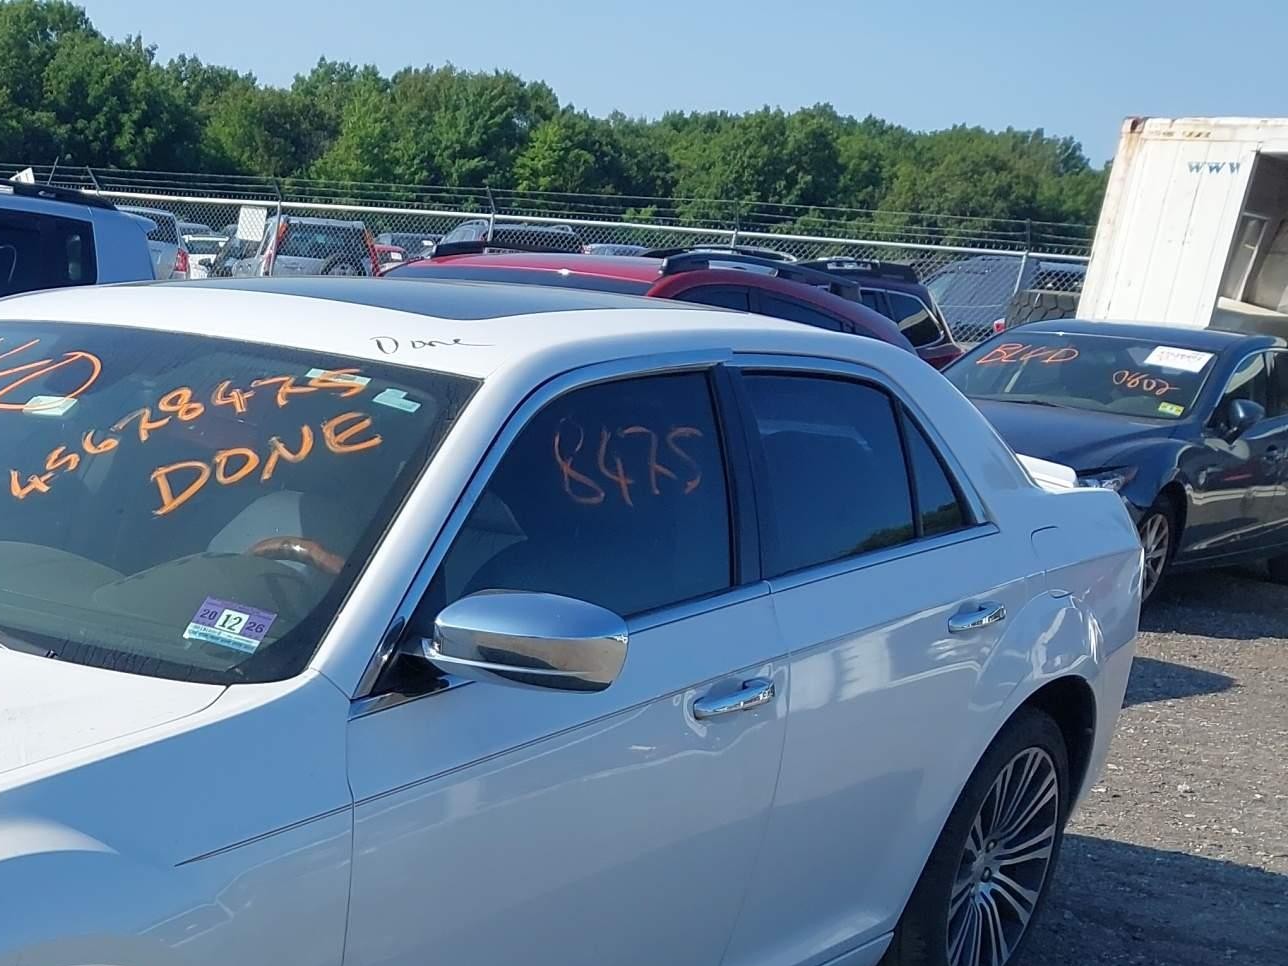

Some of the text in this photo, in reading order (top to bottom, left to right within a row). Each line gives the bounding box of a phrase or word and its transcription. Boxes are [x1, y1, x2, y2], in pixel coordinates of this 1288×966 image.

[1112, 370, 1181, 396] 0602
[10, 368, 368, 500] 45678475
[150, 412, 384, 518] DONE
[552, 416, 705, 507] 8475
[199, 608, 266, 633] 20 12 26
